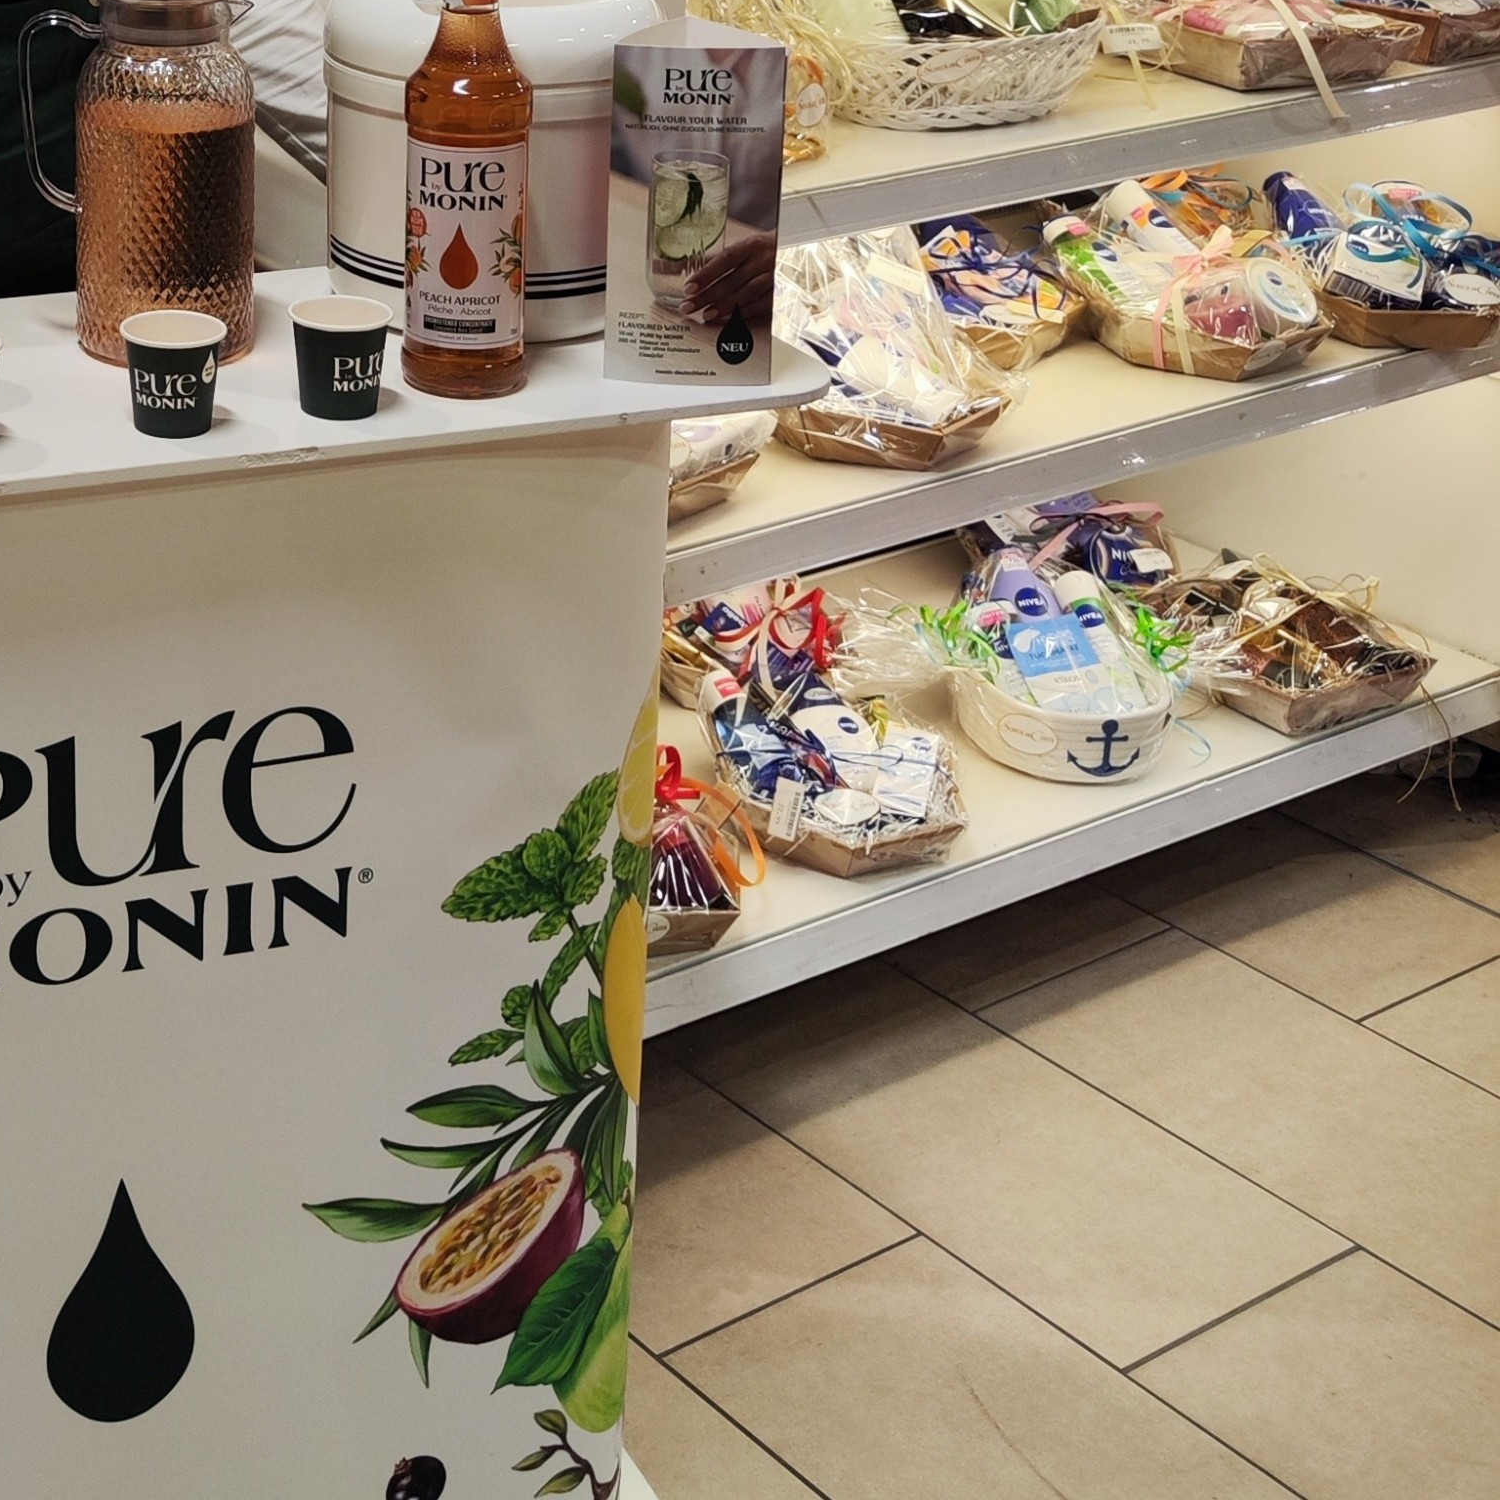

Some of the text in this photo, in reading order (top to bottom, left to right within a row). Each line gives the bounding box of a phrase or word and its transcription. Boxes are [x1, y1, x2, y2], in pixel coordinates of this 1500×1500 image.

[664, 67, 733, 92] Pure
[663, 92, 732, 106] MONIN
[644, 115, 748, 125] FLAVOUR YOUR WATER
[420, 156, 506, 193] Pure
[419, 189, 504, 212] MONIN
[419, 290, 502, 306] PEACH APRICOT
[427, 303, 492, 316] Pêche Abricot
[618, 321, 691, 333] FLAVOURED WATER
[720, 342, 749, 353] NEU
[134, 367, 198, 397] Pure
[135, 391, 196, 410] MONIN
[1018, 596, 1045, 608] NIVEA
